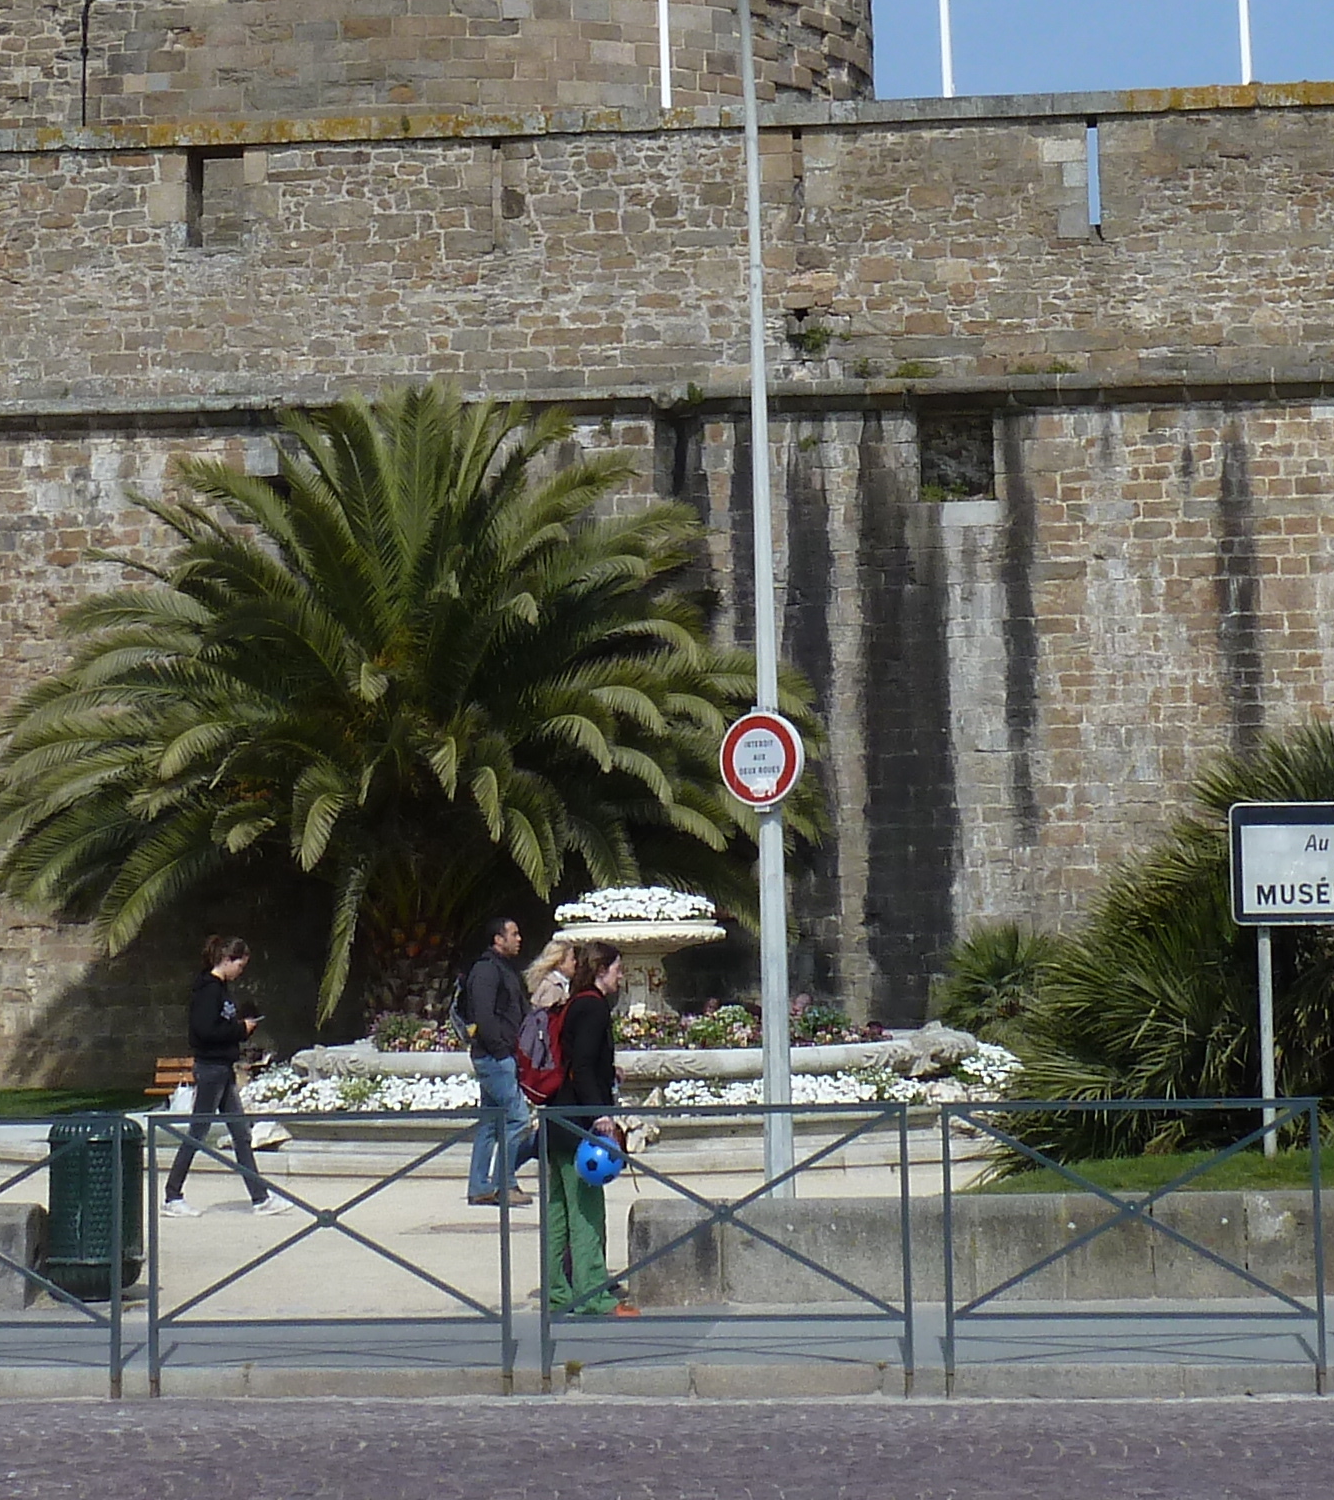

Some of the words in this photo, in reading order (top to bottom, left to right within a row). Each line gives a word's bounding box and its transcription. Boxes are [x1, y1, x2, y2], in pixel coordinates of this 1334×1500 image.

[743, 739, 773, 748] INTERDIT
[753, 753, 766, 761] AUX
[739, 767, 756, 775] DEUX
[758, 766, 780, 774] ROUES
[1305, 834, 1329, 851] Au
